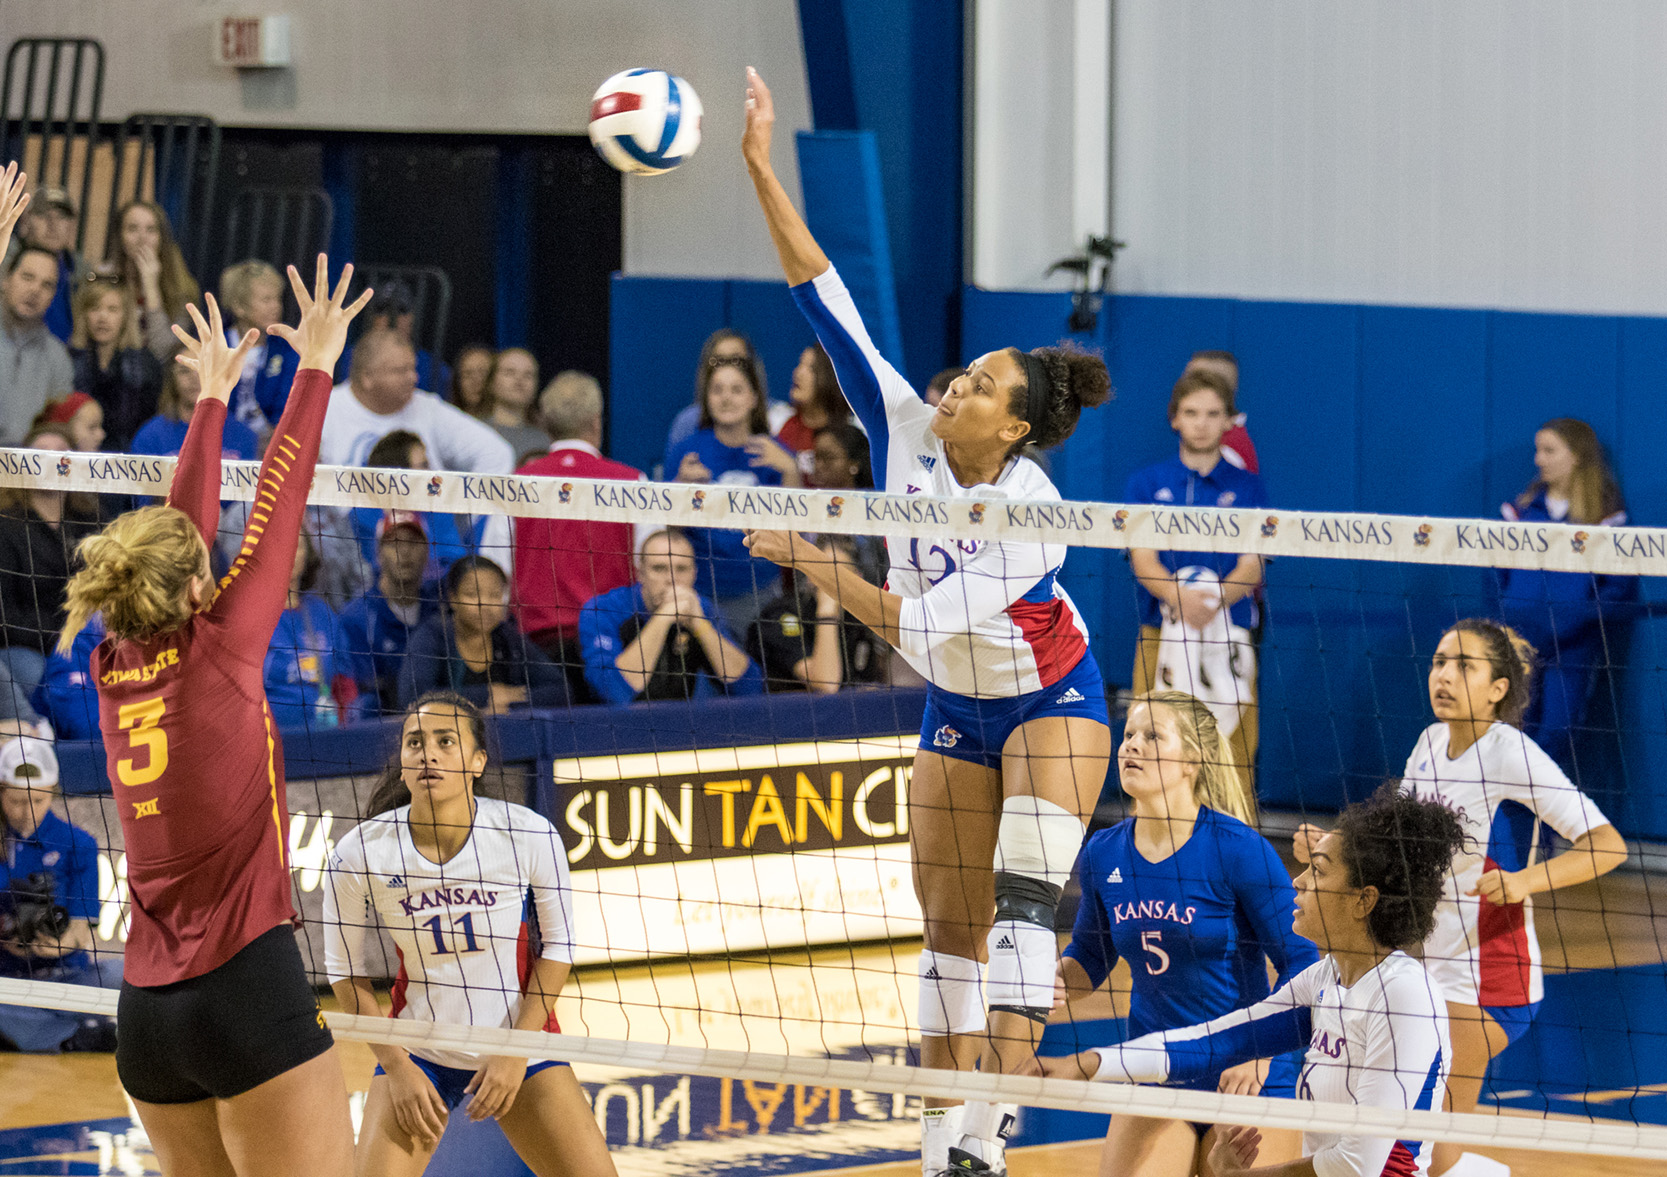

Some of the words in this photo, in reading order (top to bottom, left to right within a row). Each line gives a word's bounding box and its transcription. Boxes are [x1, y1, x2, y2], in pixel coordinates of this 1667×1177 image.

[89, 458, 162, 483] KANSAS
[335, 471, 410, 496] KANSAS
[463, 476, 540, 504] KANSAS
[594, 485, 673, 511] KANSAS
[728, 491, 809, 518] KANSAS
[864, 497, 949, 525] KANSAS
[1006, 504, 1094, 531] KANSAS
[1151, 510, 1241, 537] KANSAS
[1300, 518, 1393, 546] KANSAS
[1456, 524, 1549, 553] KANSAS
[1613, 532, 1666, 558] KAN
[1056, 694, 1085, 705] adidas
[117, 696, 169, 787] 3
[132, 798, 161, 820] XII
[565, 782, 693, 864] SUN
[704, 770, 843, 848] TAN
[398, 888, 499, 917] KANSAS
[1113, 900, 1196, 925] KANSAS
[422, 911, 485, 956] 11
[1141, 931, 1170, 976] 5
